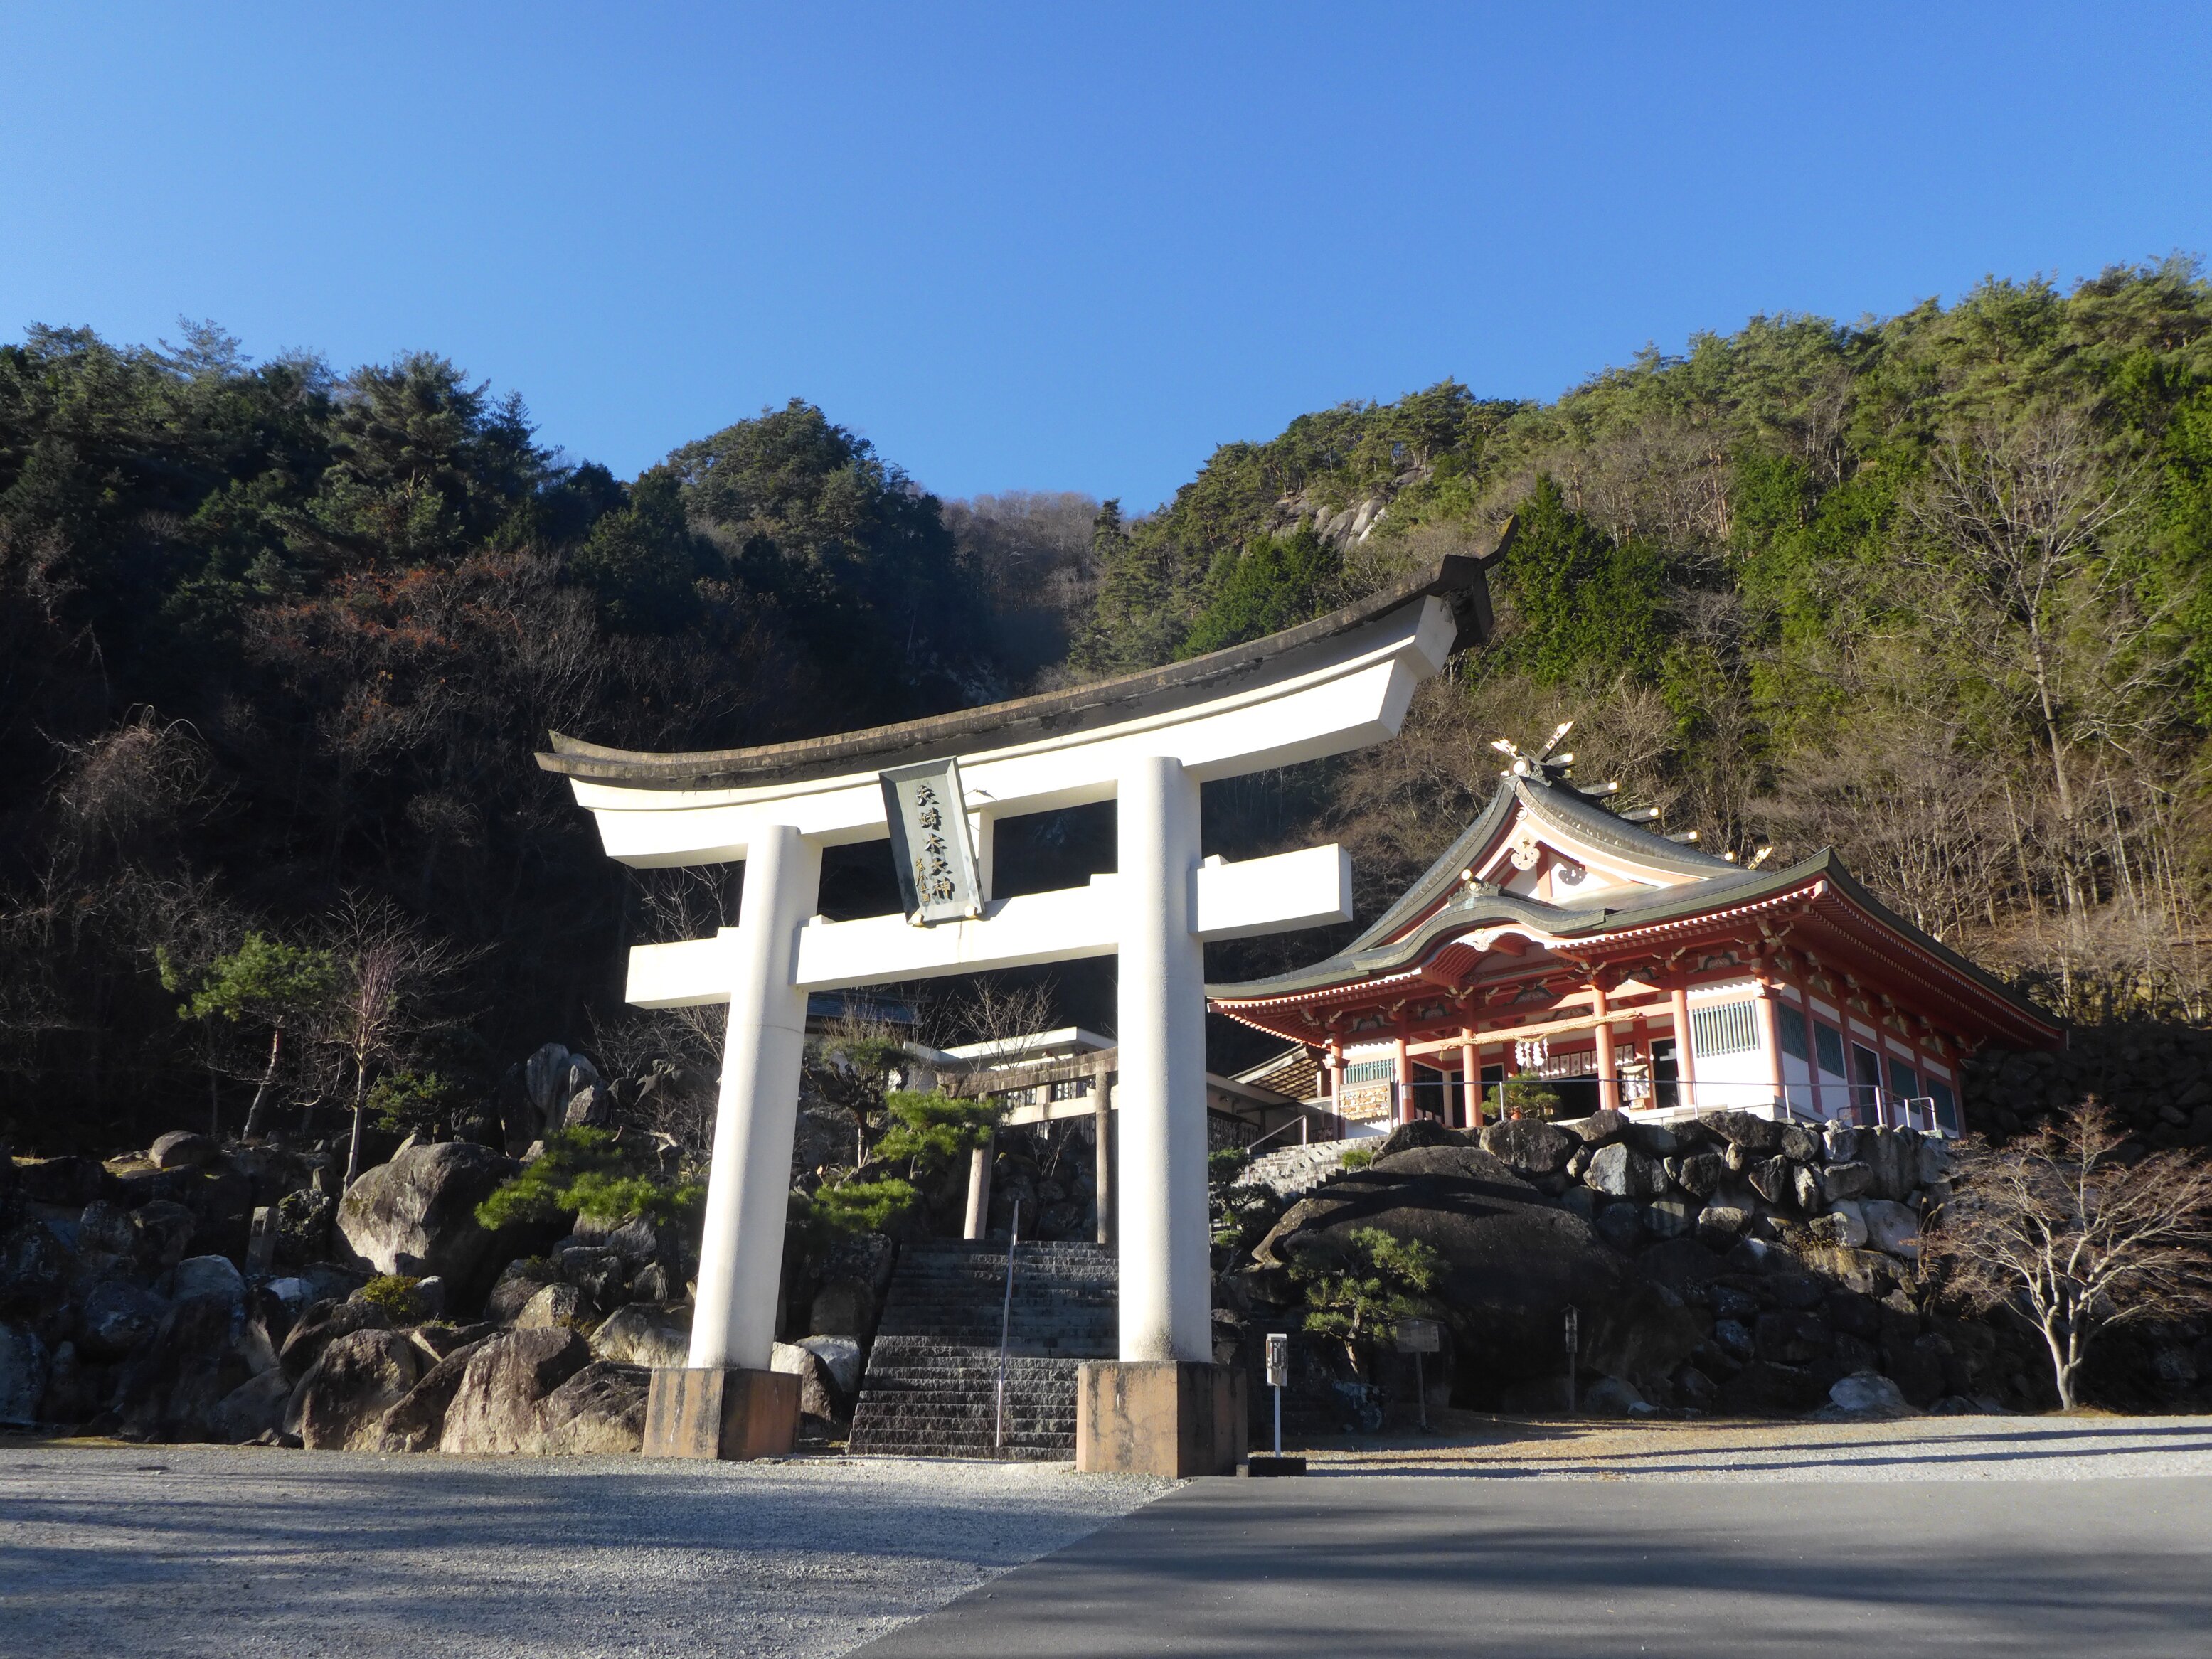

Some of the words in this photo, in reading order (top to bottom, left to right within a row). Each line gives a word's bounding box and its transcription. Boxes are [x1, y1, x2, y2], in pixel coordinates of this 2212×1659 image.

[916, 785, 955, 900] 夫婦木大神
